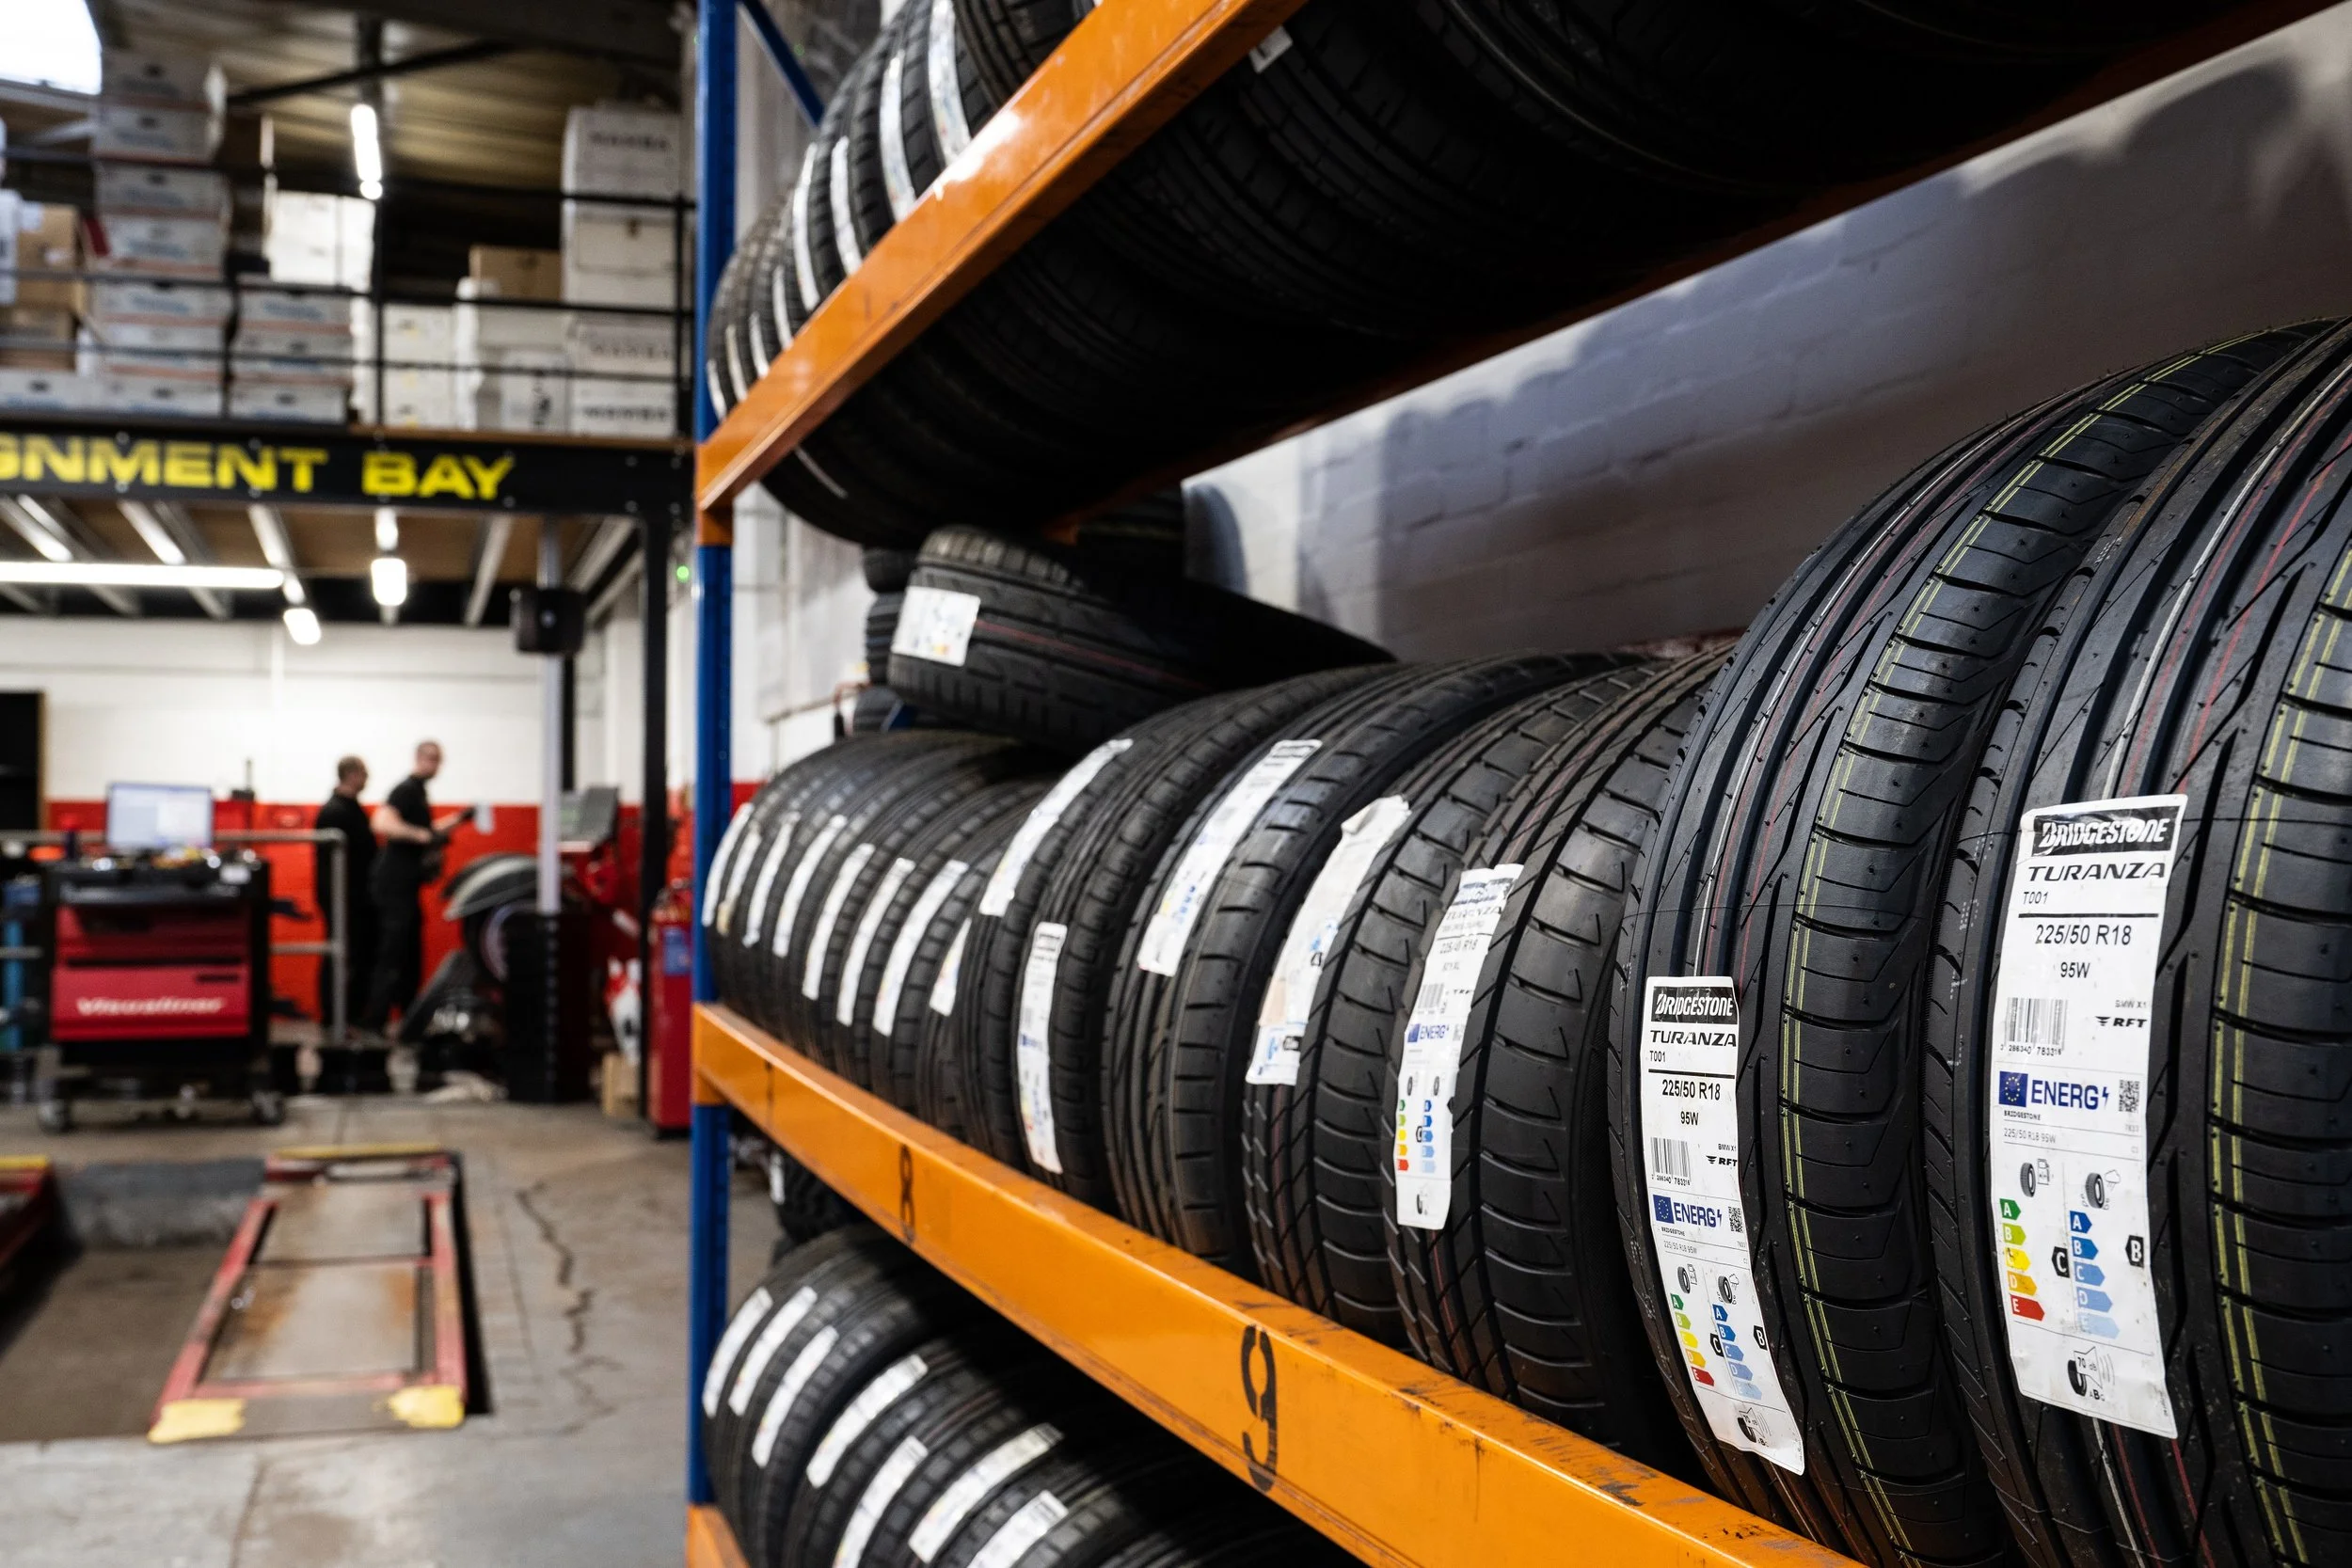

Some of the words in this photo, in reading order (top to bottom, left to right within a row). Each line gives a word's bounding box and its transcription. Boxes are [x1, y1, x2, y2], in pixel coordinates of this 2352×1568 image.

[362, 451, 515, 500] BAY
[2037, 817, 2170, 849] BRIDGESTONE
[2028, 863, 2166, 882] TURANZA
[2023, 892, 2048, 905] T001
[2035, 925, 2090, 944] 225/50
[2096, 925, 2132, 945] R18
[2060, 961, 2090, 978] 95W
[1655, 993, 1734, 1016] BRIDGESTONE
[2113, 1018, 2147, 1028] RFT
[1650, 1030, 1737, 1047] TURANZA
[1649, 1051, 1665, 1062] T001
[1662, 1079, 1695, 1098] 225/50
[1699, 1082, 1721, 1101] R18
[2031, 1080, 2099, 1110] ENERG
[1680, 1111, 1699, 1126] 95W
[2003, 1110, 2042, 1120] BRIDGESTONE
[2004, 1128, 2026, 1139] 225/50
[2028, 1131, 2039, 1141] R18
[1719, 1157, 1738, 1167] RFT
[899, 1144, 915, 1244] 8
[1674, 1202, 1717, 1227] ENERG
[2003, 1202, 2011, 1217] A
[2073, 1214, 2082, 1230] A
[2005, 1227, 2012, 1241] B
[2074, 1240, 2082, 1255] B
[2130, 1240, 2141, 1262] B
[2056, 1252, 2067, 1273] C
[2077, 1266, 2085, 1280] C
[2010, 1275, 2017, 1289] D
[1674, 1297, 1679, 1307] A
[2012, 1298, 2020, 1312] E
[2079, 1291, 2088, 1305] D
[1677, 1315, 1682, 1325] B
[1716, 1307, 1723, 1319] A
[1720, 1327, 1726, 1338] B
[1756, 1330, 1765, 1346] B
[1713, 1337, 1721, 1353] C
[1725, 1346, 1731, 1356] C
[2077, 1356, 2086, 1369] 70
[1693, 1370, 1699, 1381] E
[1731, 1366, 1738, 1375] D
[1241, 1324, 1278, 1493] 9
